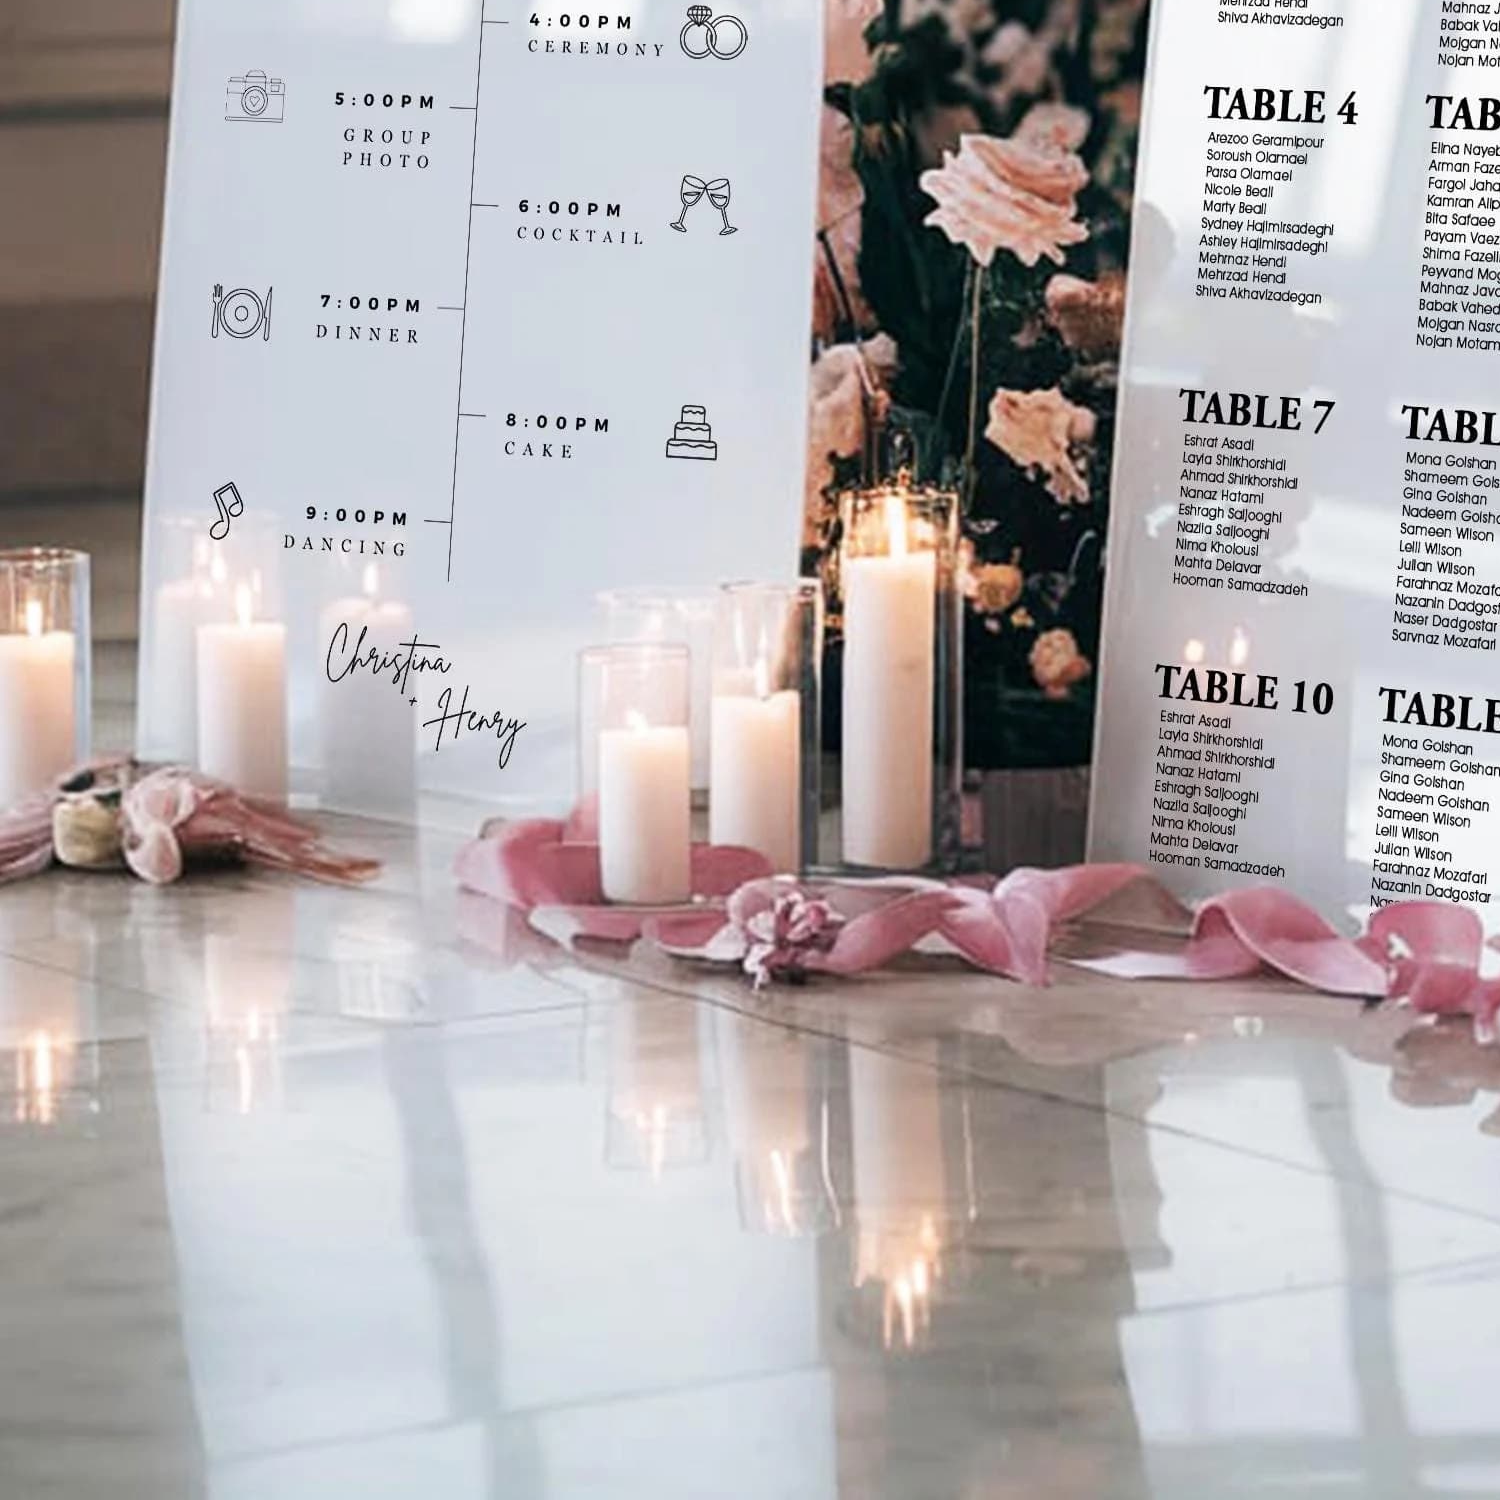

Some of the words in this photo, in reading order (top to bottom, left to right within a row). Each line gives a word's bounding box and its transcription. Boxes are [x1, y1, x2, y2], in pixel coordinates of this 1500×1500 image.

[1441, 0, 1491, 15] Mahnaz
[529, 12, 631, 30] 4:00PM
[1440, 18, 1480, 32] Babak
[527, 39, 664, 57] CEREMONY
[334, 91, 434, 110] 5:00PM
[1203, 84, 1326, 124] TABLE
[1336, 90, 1359, 125] 4
[343, 128, 431, 145] GROUP
[343, 151, 429, 169] PHOTO
[1428, 176, 1467, 194] Fargol
[518, 199, 621, 218] 6:00PM
[1202, 199, 1236, 216] Marty
[1451, 212, 1496, 228] Safaee
[516, 226, 643, 245] COCKTAIL
[1198, 251, 1250, 266] Mehrnaz
[1421, 264, 1474, 280] Peyvand
[1420, 280, 1470, 296] Mahnaz
[320, 294, 420, 313] 7:00PM
[316, 324, 418, 344] DINNER
[1178, 387, 1302, 431] TABLE
[1312, 400, 1336, 435] 7
[505, 412, 609, 433] 8:00PM
[504, 440, 572, 459] CAKE
[1184, 433, 1219, 449] Eshrat
[1405, 451, 1442, 466] Mona
[1444, 454, 1497, 471] Golshan
[1404, 468, 1469, 487] Shameem
[306, 505, 407, 526] 9:00PM
[1401, 504, 1457, 521] Nadeem
[283, 534, 405, 557] DANCING
[1174, 554, 1213, 570] Mahta
[1215, 558, 1262, 575] Delavar
[1172, 571, 1224, 589] Hooman
[1227, 577, 1308, 597] Samadzadeh
[1393, 610, 1429, 627] Naser
[1432, 614, 1498, 633] Dadgostar
[326, 622, 452, 695] Christina
[1154, 663, 1279, 711] TABLE
[1291, 680, 1334, 716] 10
[1160, 709, 1196, 725] Eshrat
[422, 684, 528, 770] Henry
[1382, 733, 1418, 750] Mona
[1422, 738, 1474, 756] Golshan
[1380, 751, 1446, 771] Shameem
[1449, 759, 1500, 778] Golshan
[1378, 787, 1434, 806] Nadeem
[1437, 794, 1490, 813] Golshan
[1150, 831, 1189, 848] Mahta
[1192, 836, 1239, 855] Delavar
[1149, 849, 1201, 868] Hooman
[1203, 856, 1286, 878] Samadzadeh
